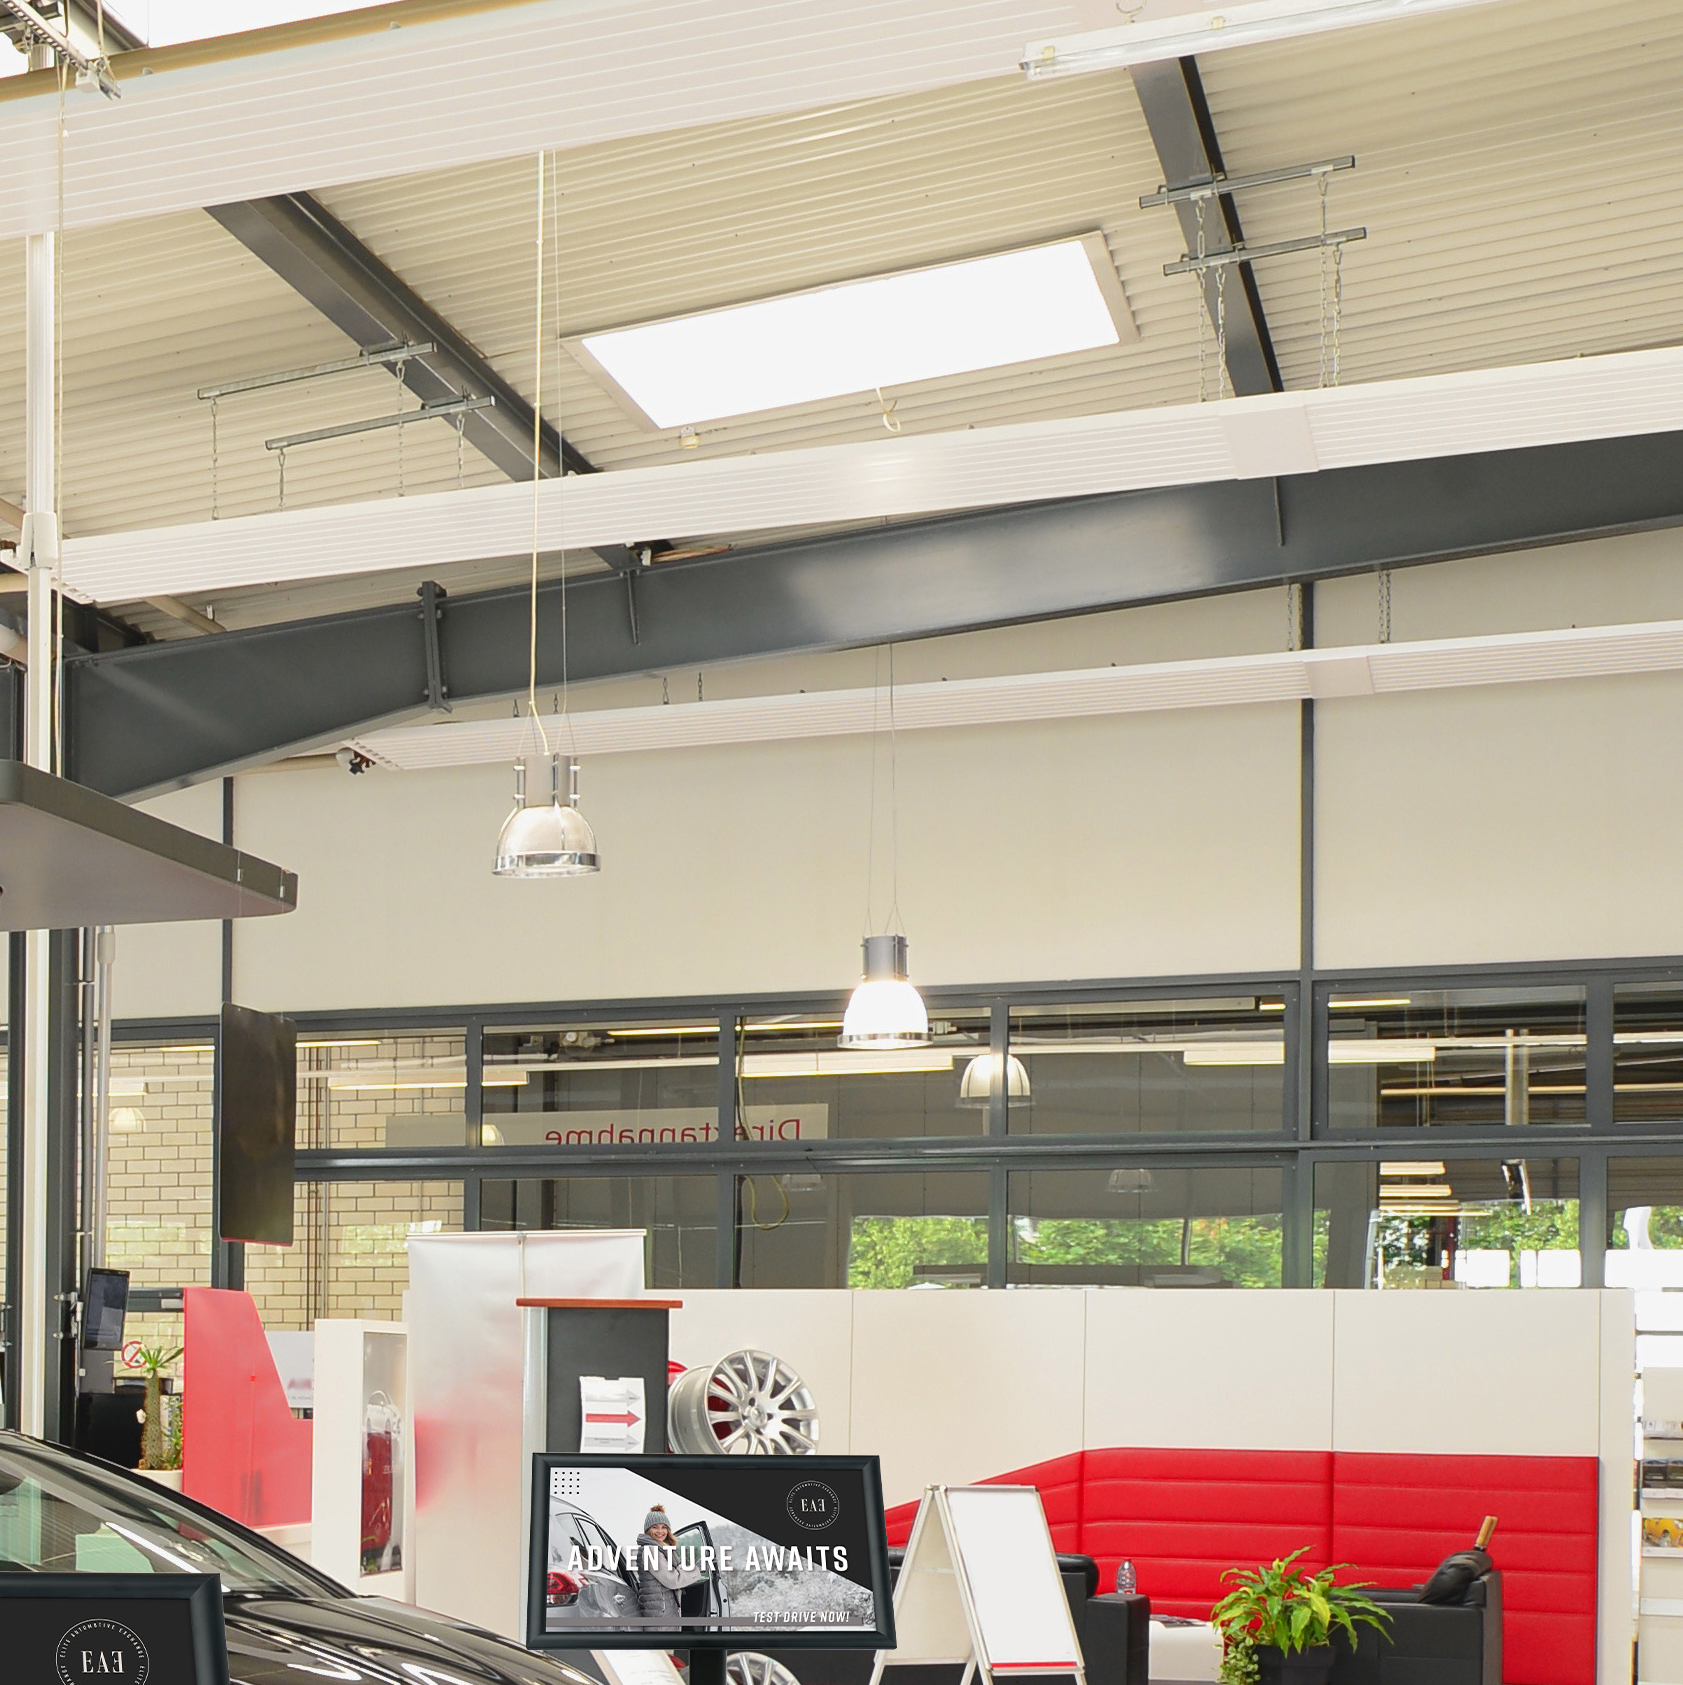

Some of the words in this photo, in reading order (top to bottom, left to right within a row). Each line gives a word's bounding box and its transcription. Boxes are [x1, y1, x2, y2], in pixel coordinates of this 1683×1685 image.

[567, 1545, 734, 1572] ADVENTURE
[745, 1545, 849, 1572] AWAITS
[753, 1611, 781, 1623] TEST
[783, 1611, 817, 1623] DRIVE
[820, 1611, 850, 1623] NOW!
